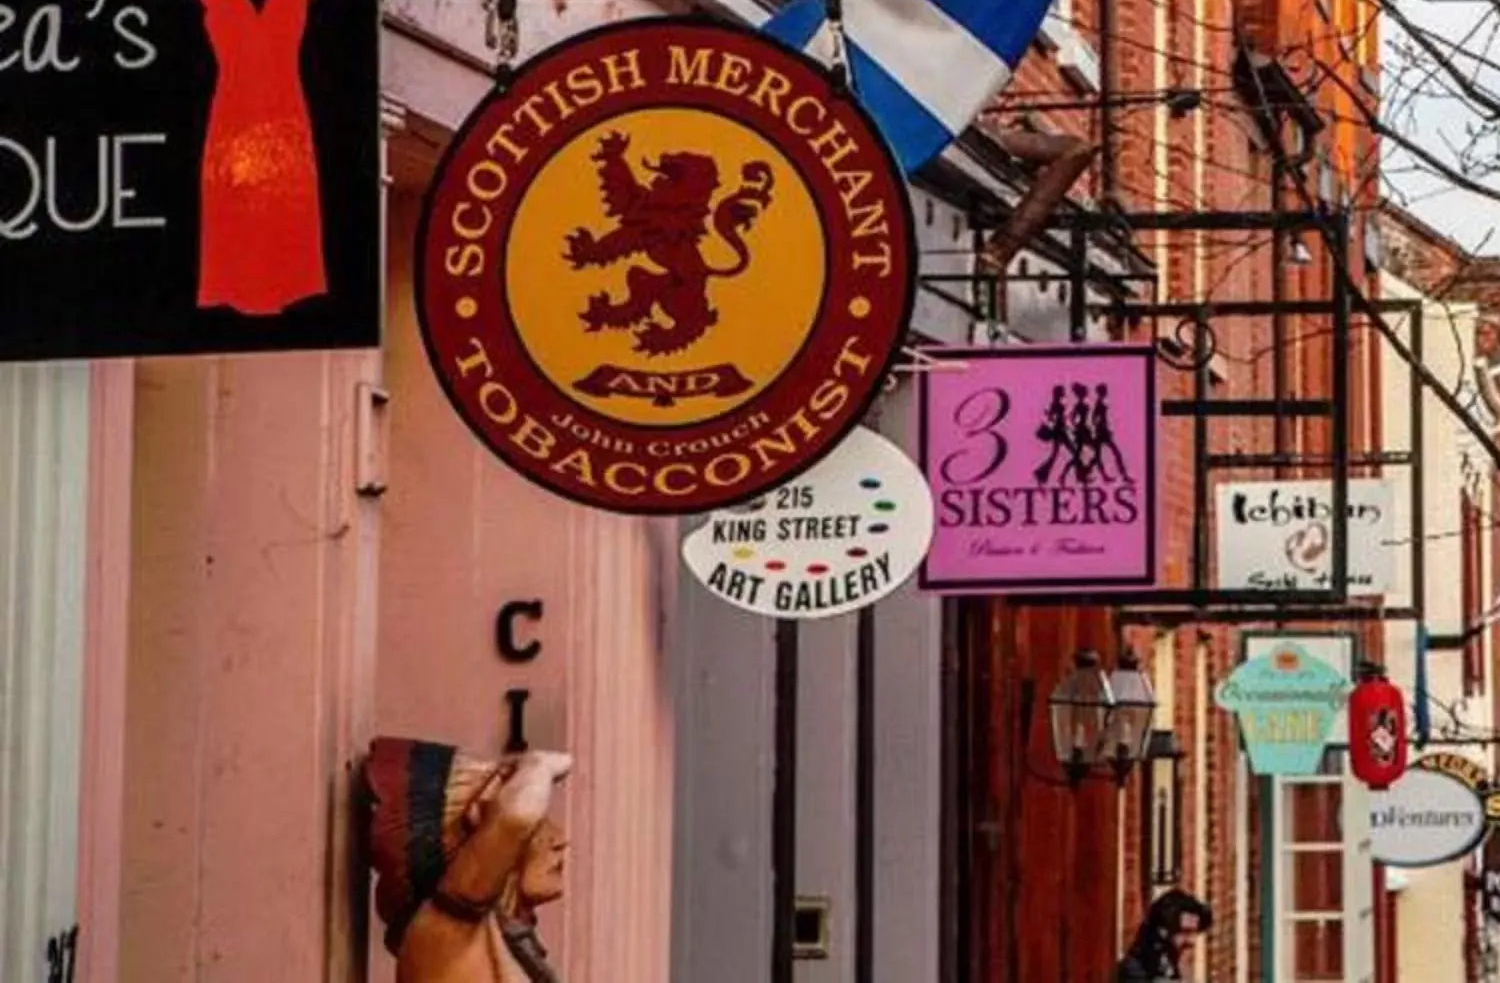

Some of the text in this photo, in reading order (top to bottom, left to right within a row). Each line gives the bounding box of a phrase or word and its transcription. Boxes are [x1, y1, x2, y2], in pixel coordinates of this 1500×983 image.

[445, 46, 892, 278] SCOTTISH MERCHANT
[607, 372, 720, 393] AND
[456, 338, 872, 495] TOBACCONIST
[551, 410, 769, 457] John Crouch
[940, 387, 1010, 484] 3
[776, 486, 814, 510] 215
[939, 486, 1138, 527] SISTERS
[1232, 488, 1381, 525] Ichibn
[713, 515, 861, 544] KING STREET
[708, 552, 892, 612] ART GALLERY
